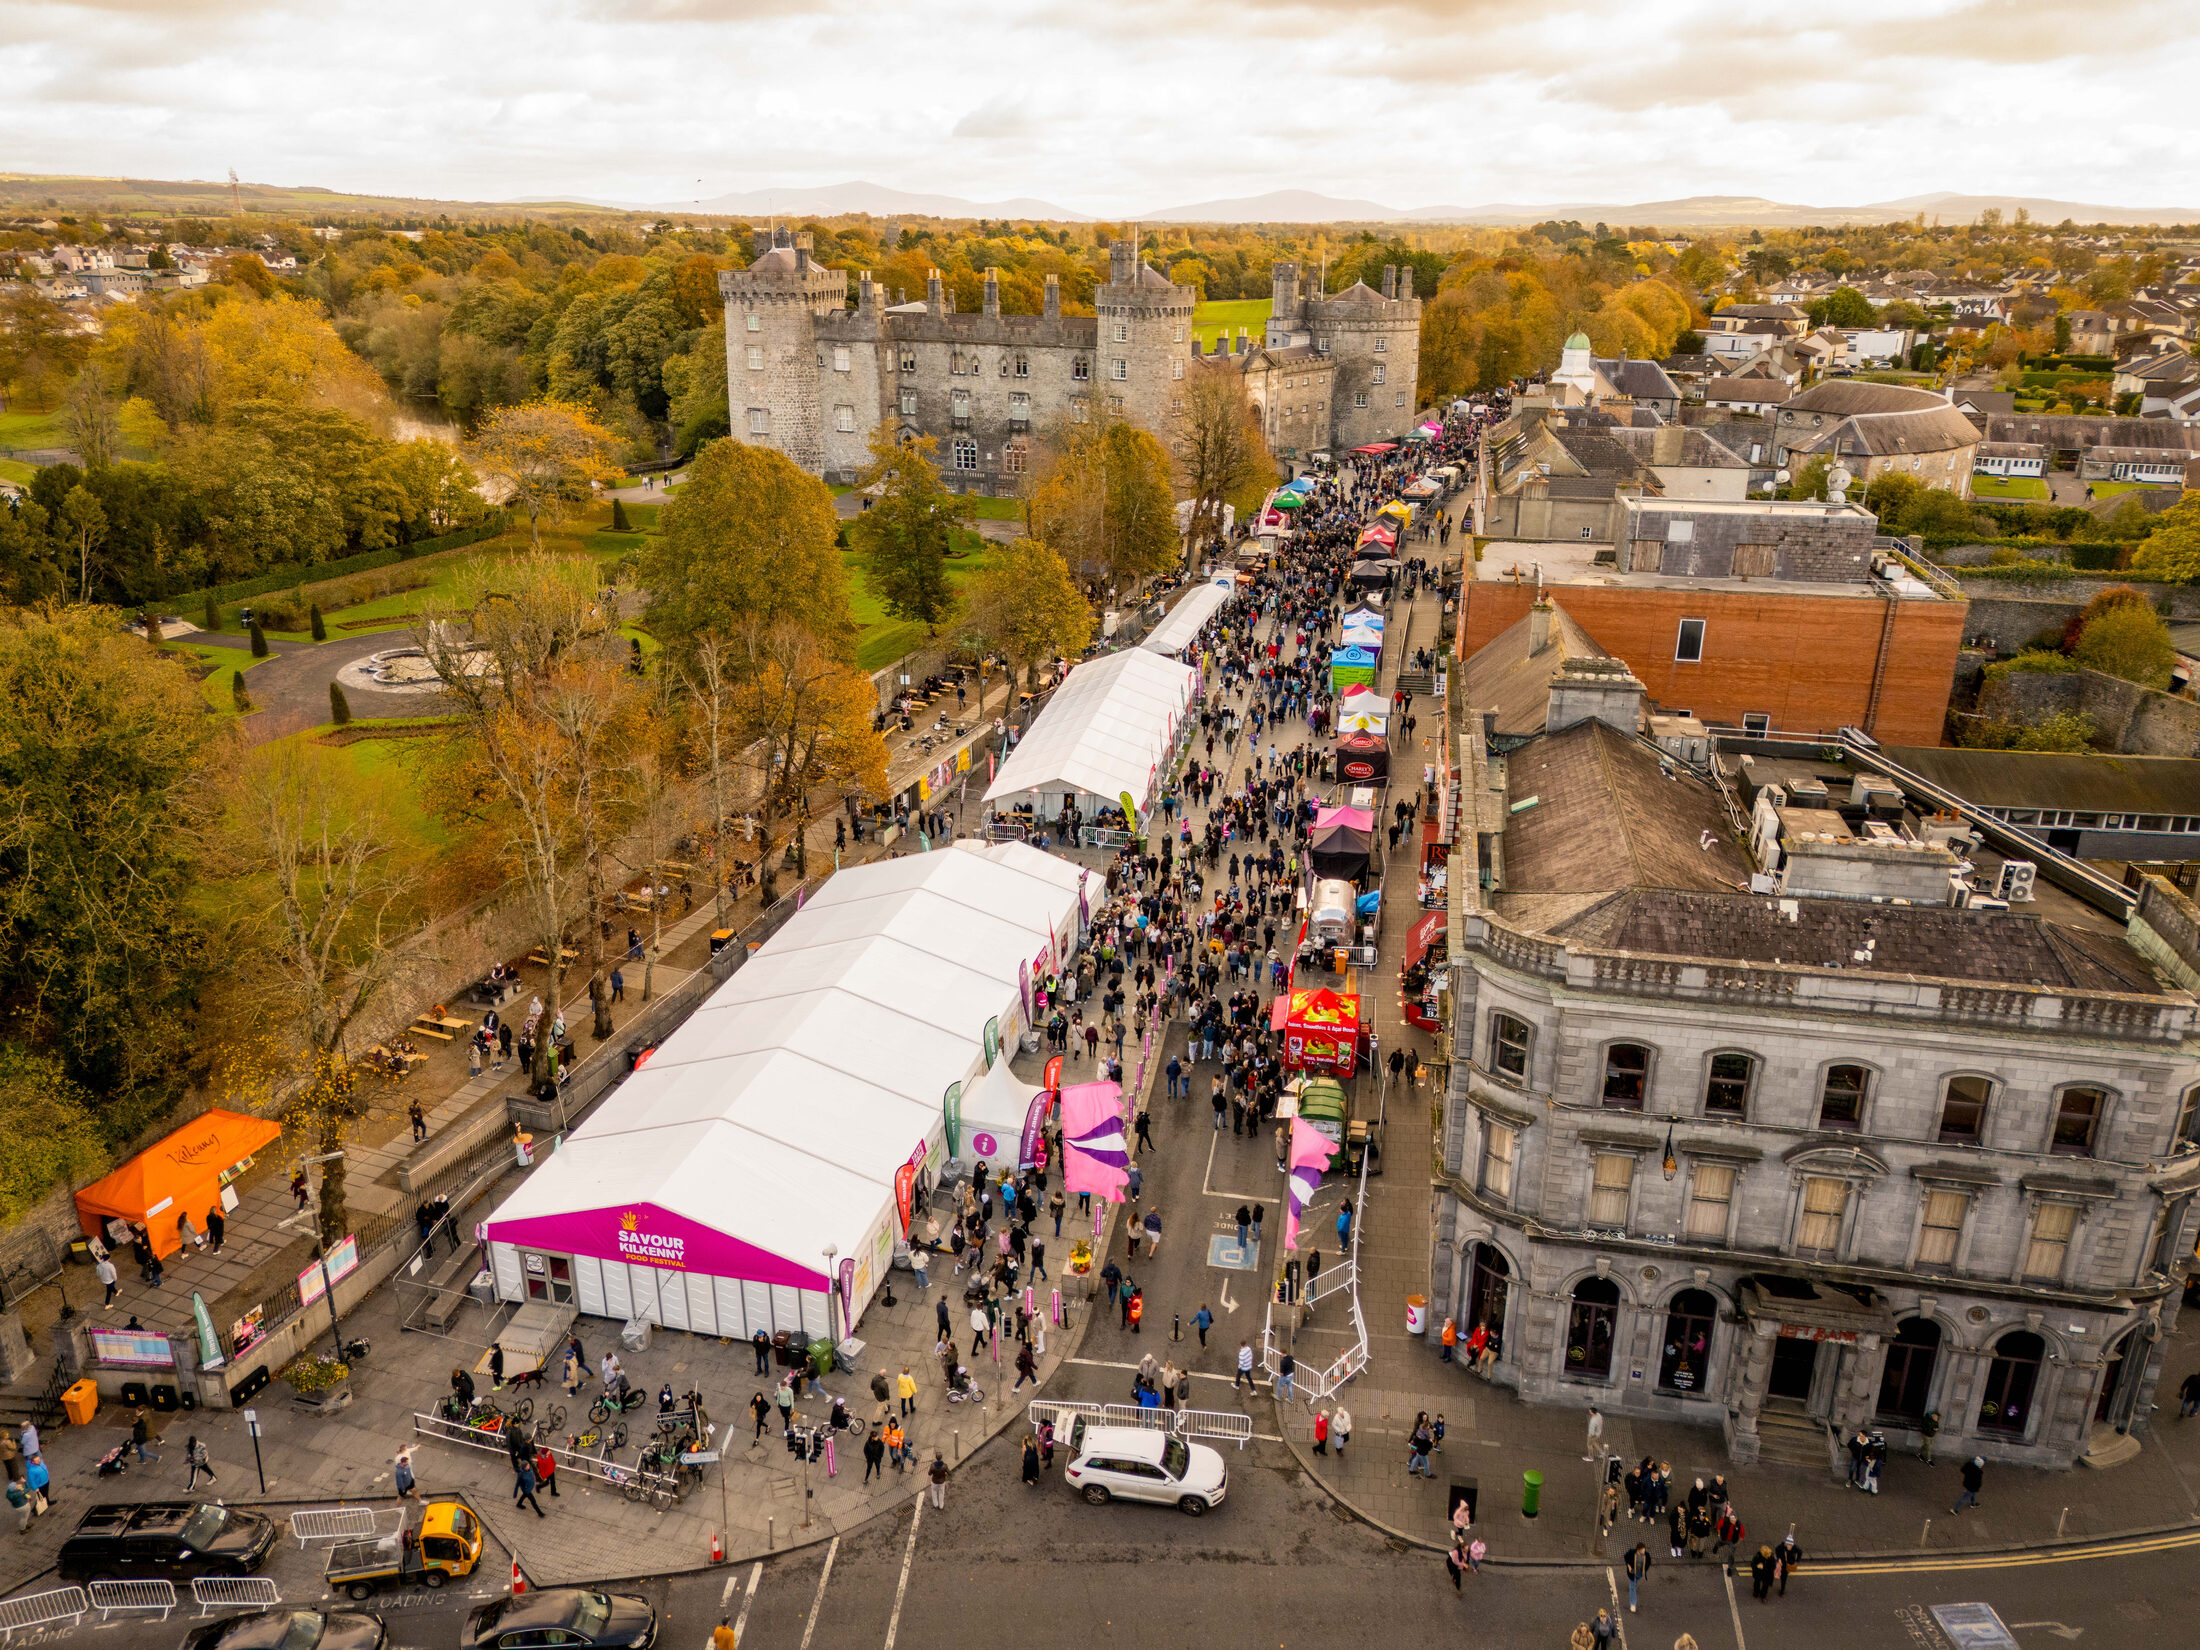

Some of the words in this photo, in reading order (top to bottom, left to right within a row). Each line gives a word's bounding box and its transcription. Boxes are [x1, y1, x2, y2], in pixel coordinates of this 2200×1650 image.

[618, 1230, 685, 1250] SAVOUR
[619, 1242, 685, 1260] KILKENNY
[625, 1253, 648, 1262] FOOD
[649, 1257, 686, 1267] FESTIVAL
[1780, 1324, 1811, 1338] LEFT
[1813, 1327, 1857, 1343] BANK
[366, 1593, 447, 1610] LOADING
